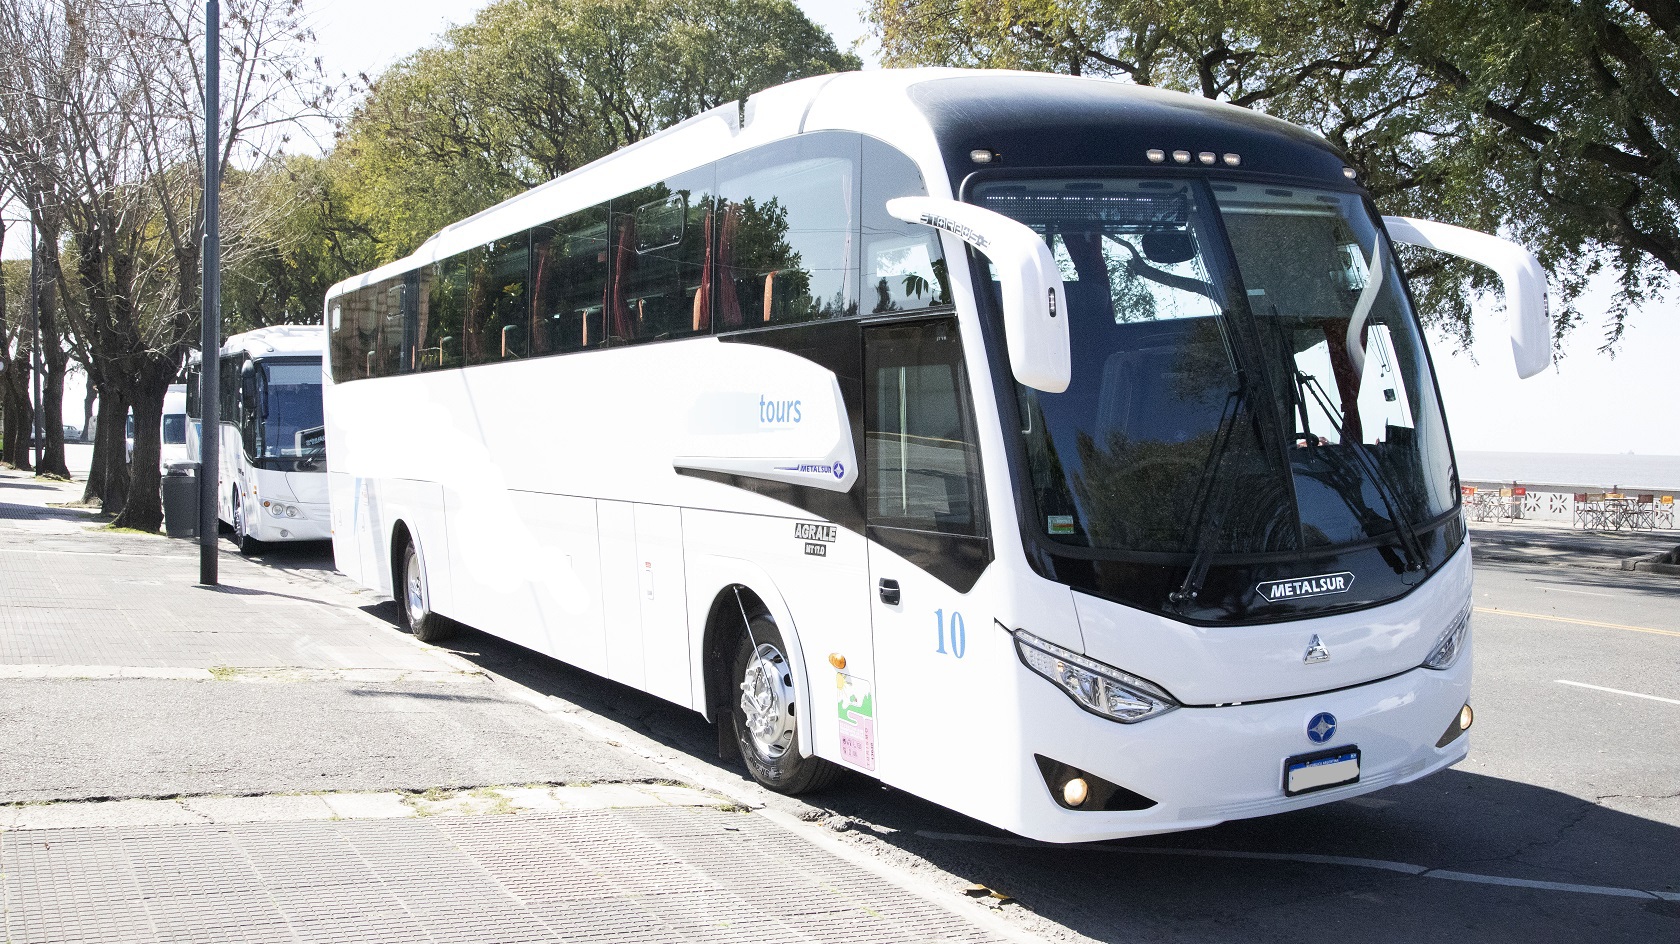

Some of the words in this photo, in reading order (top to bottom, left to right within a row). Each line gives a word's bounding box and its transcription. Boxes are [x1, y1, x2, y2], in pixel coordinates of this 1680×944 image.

[759, 394, 802, 423] tours
[800, 464, 832, 474] METALSUR
[795, 523, 837, 543] AGRALE
[1270, 576, 1345, 598] METALSUR
[934, 608, 966, 659] 10
